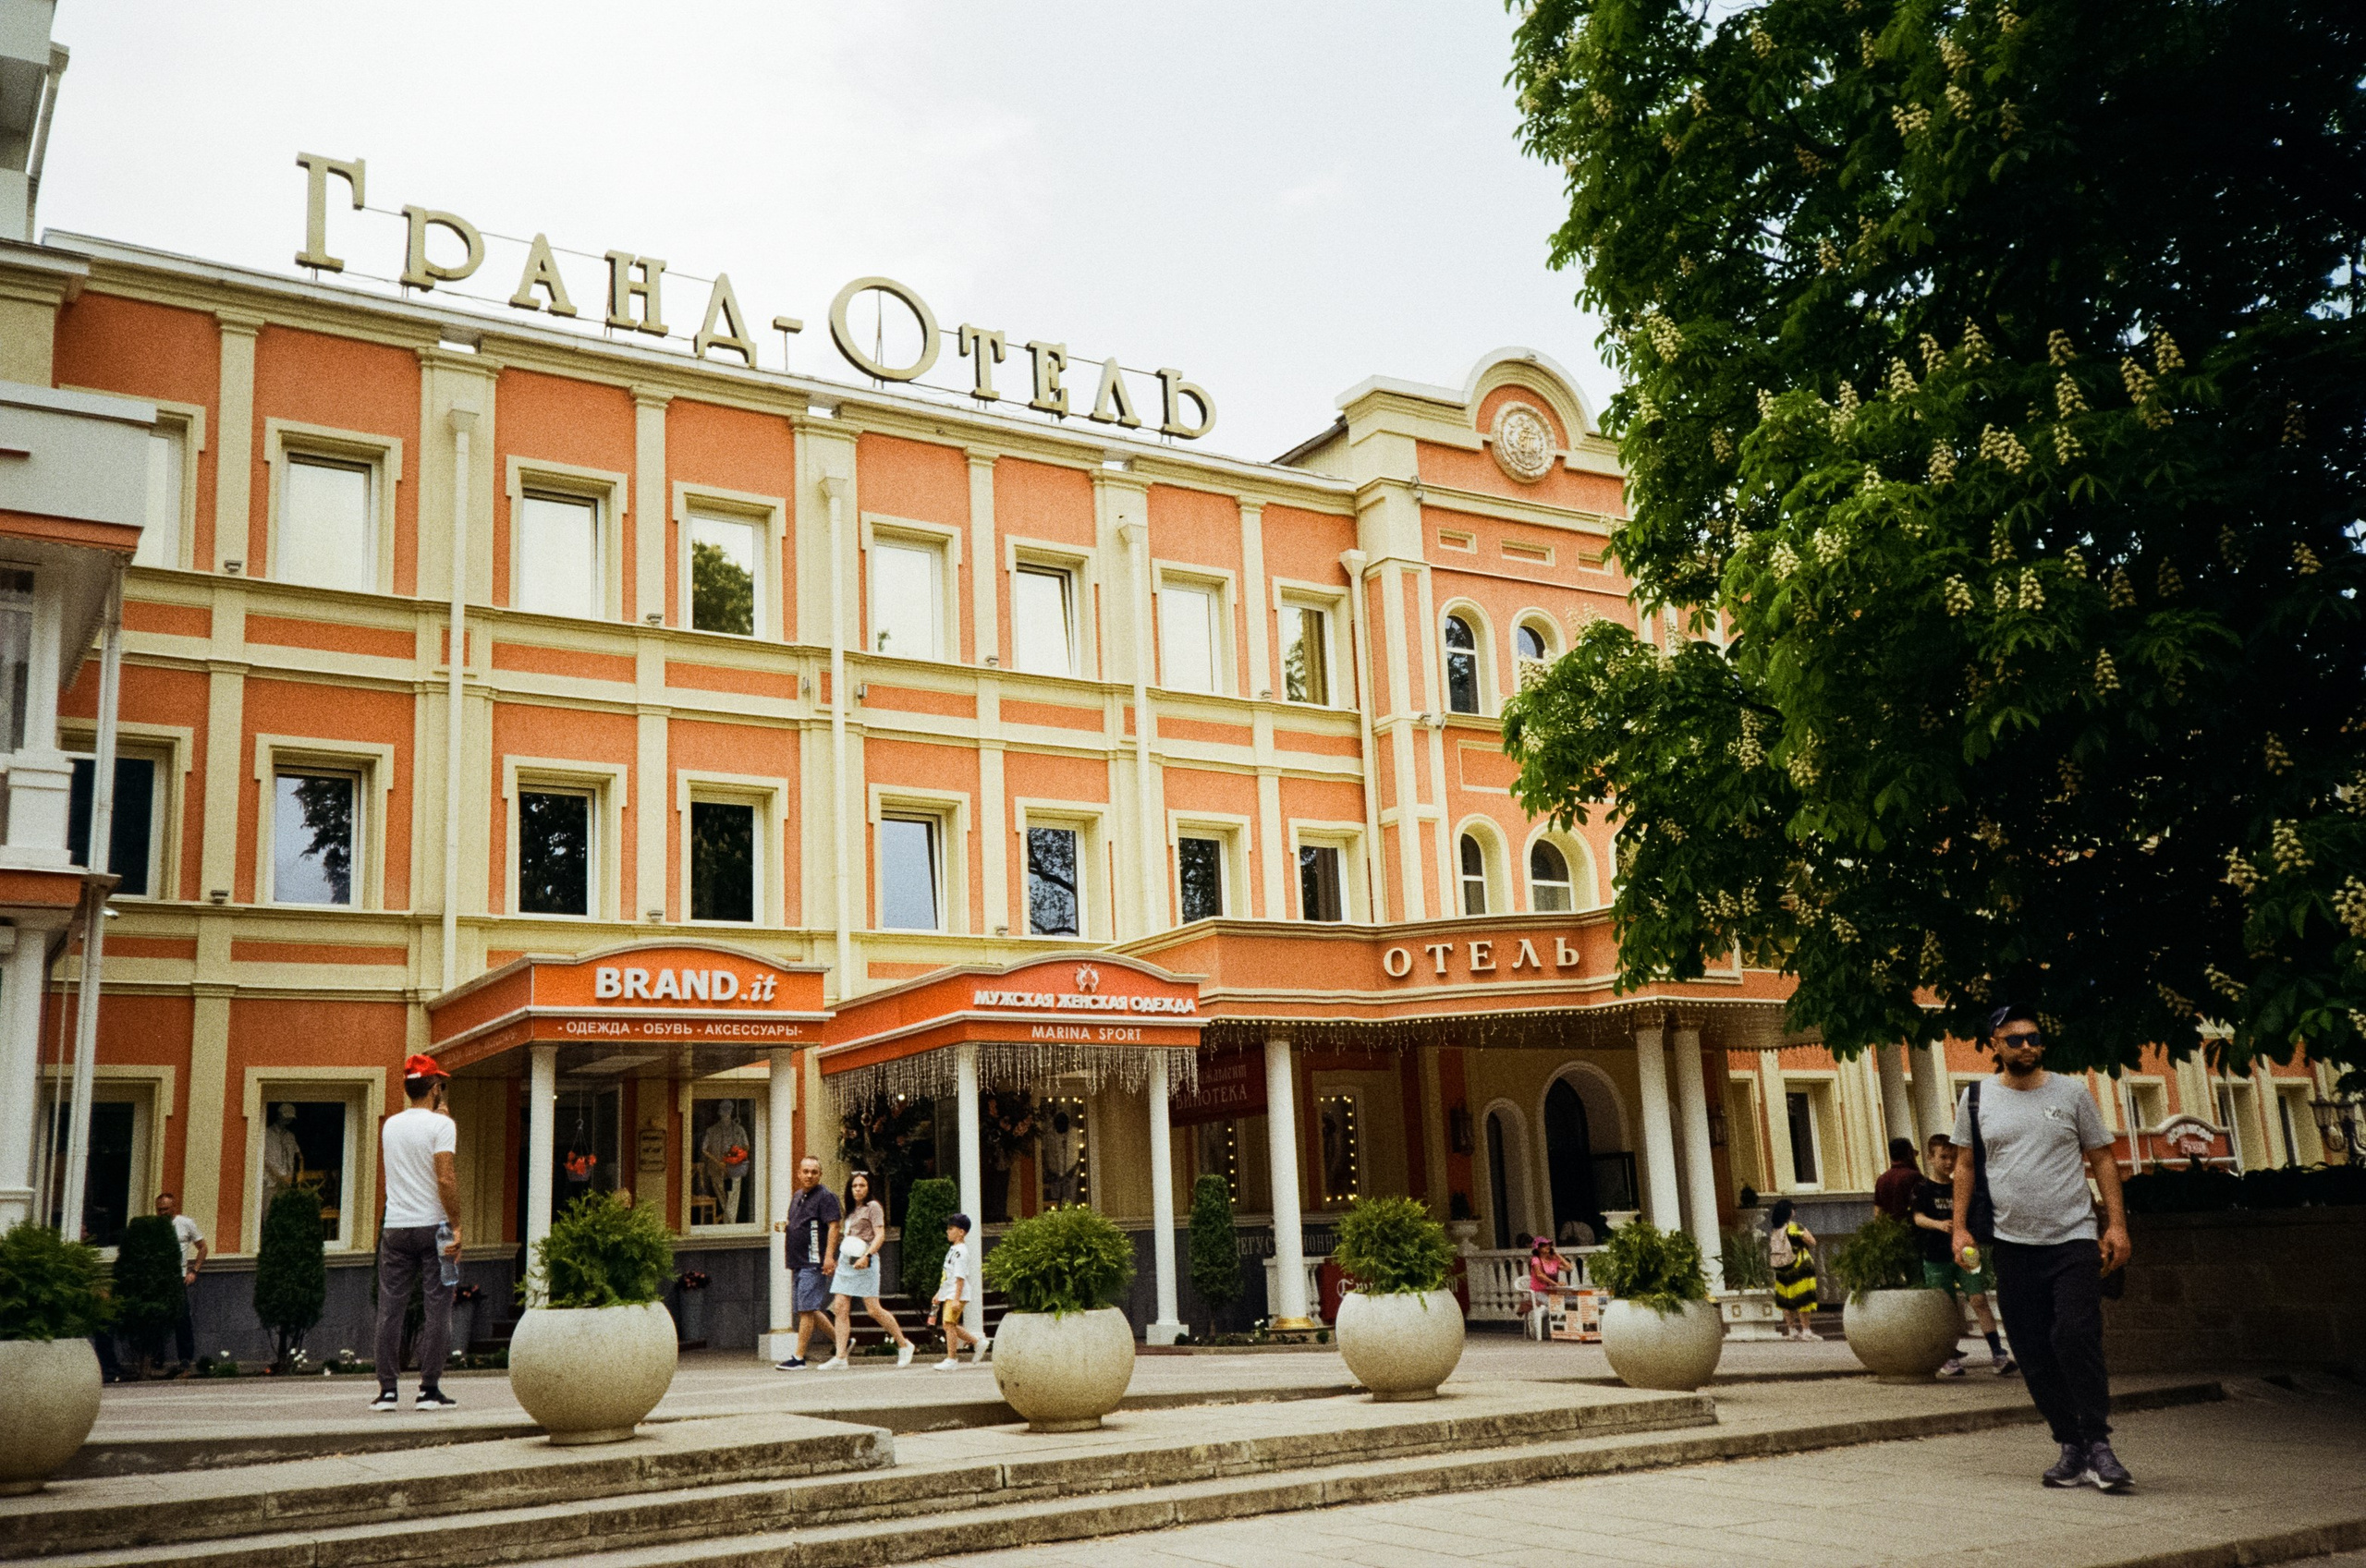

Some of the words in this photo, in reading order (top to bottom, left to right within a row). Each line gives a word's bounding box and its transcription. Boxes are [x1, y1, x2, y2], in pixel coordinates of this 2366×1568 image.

[1383, 937, 1579, 977] ОТЕЛЬ
[595, 966, 778, 1002] BRAND.it
[974, 991, 1055, 1008] МУЖСКАЯ
[1056, 994, 1128, 1011] ЖЕНСКАЯ
[1130, 996, 1197, 1014] ОДЕЖДА
[567, 1022, 630, 1035] ОДЕЖДА
[643, 1023, 693, 1035] ОБУВЬ
[1031, 1026, 1092, 1040] MARINA
[1099, 1027, 1141, 1041] SPORT
